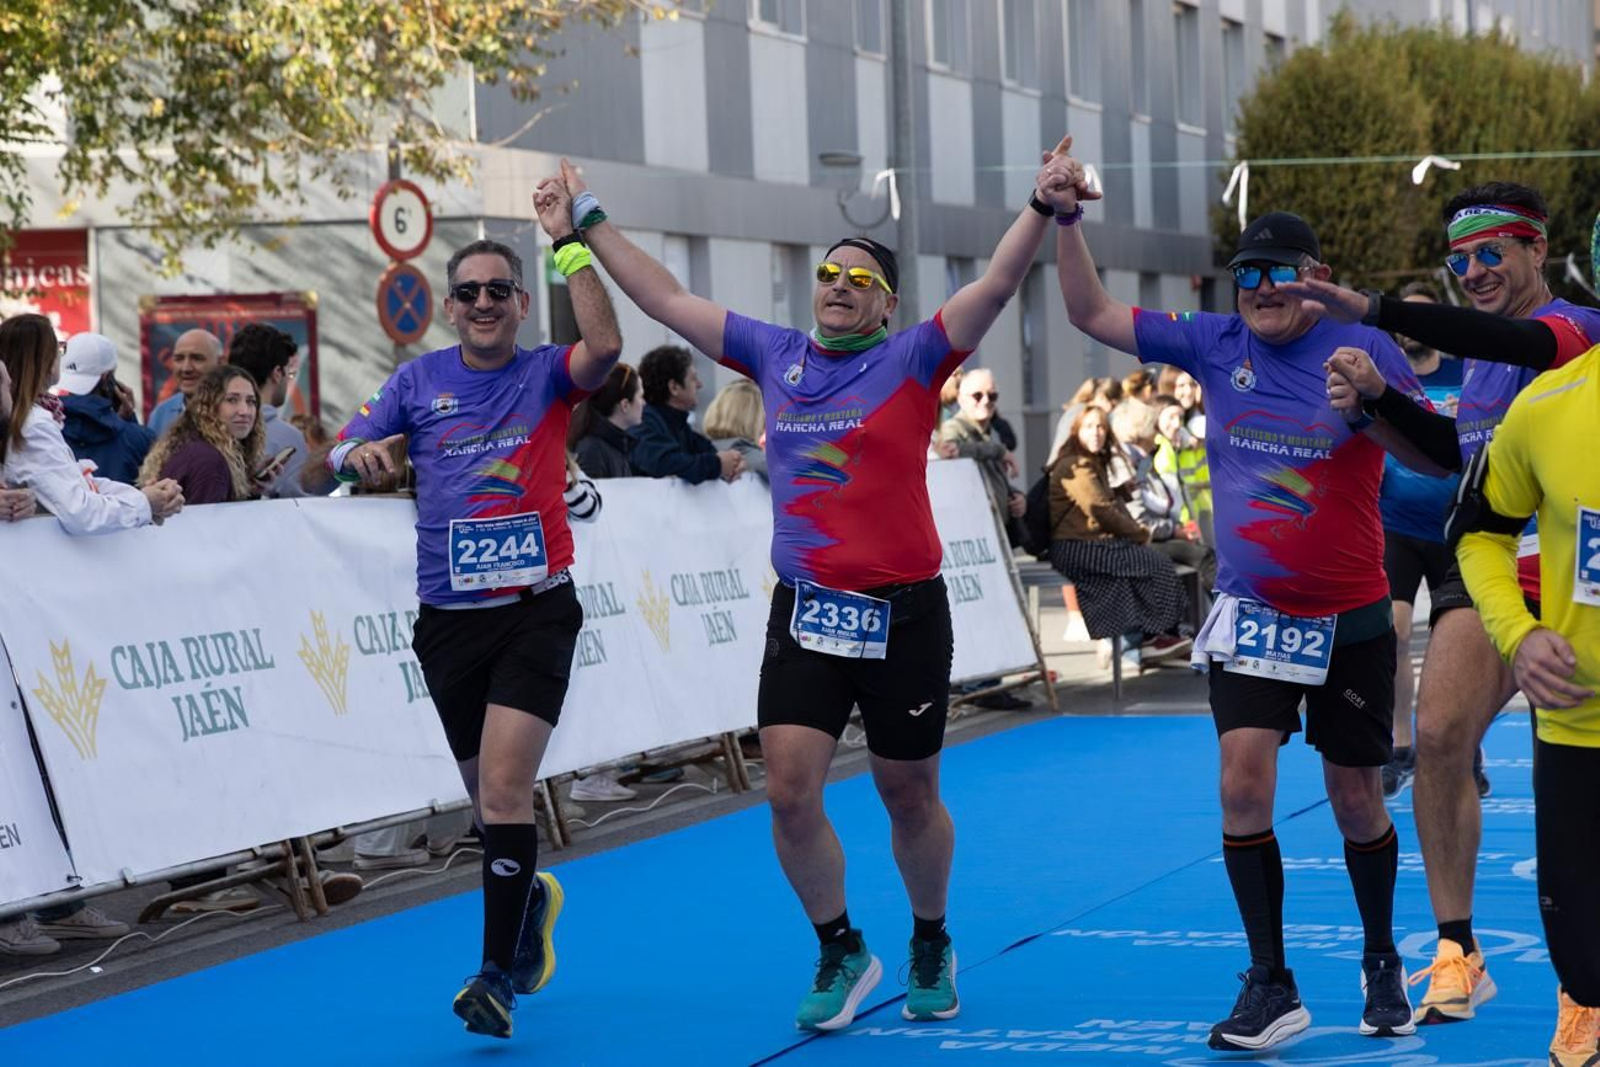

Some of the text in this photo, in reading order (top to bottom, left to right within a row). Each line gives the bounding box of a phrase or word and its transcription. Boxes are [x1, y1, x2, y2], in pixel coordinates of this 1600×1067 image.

[498, 436, 531, 448] REAL
[829, 418, 865, 431] REAL
[1292, 447, 1334, 460] REAL
[457, 532, 540, 564] 2244
[948, 538, 997, 568] RURAL
[670, 568, 750, 608] CAJA RURAL
[353, 611, 411, 657] CAJA
[700, 605, 738, 648] JAÉN
[800, 599, 882, 633] 2336
[576, 622, 608, 671] AÉN
[1237, 620, 1325, 658] 2192
[110, 628, 276, 690] CAJA RURAL
[171, 681, 250, 743] JAÉN
[937, 1040, 1184, 1055] MEDIA
